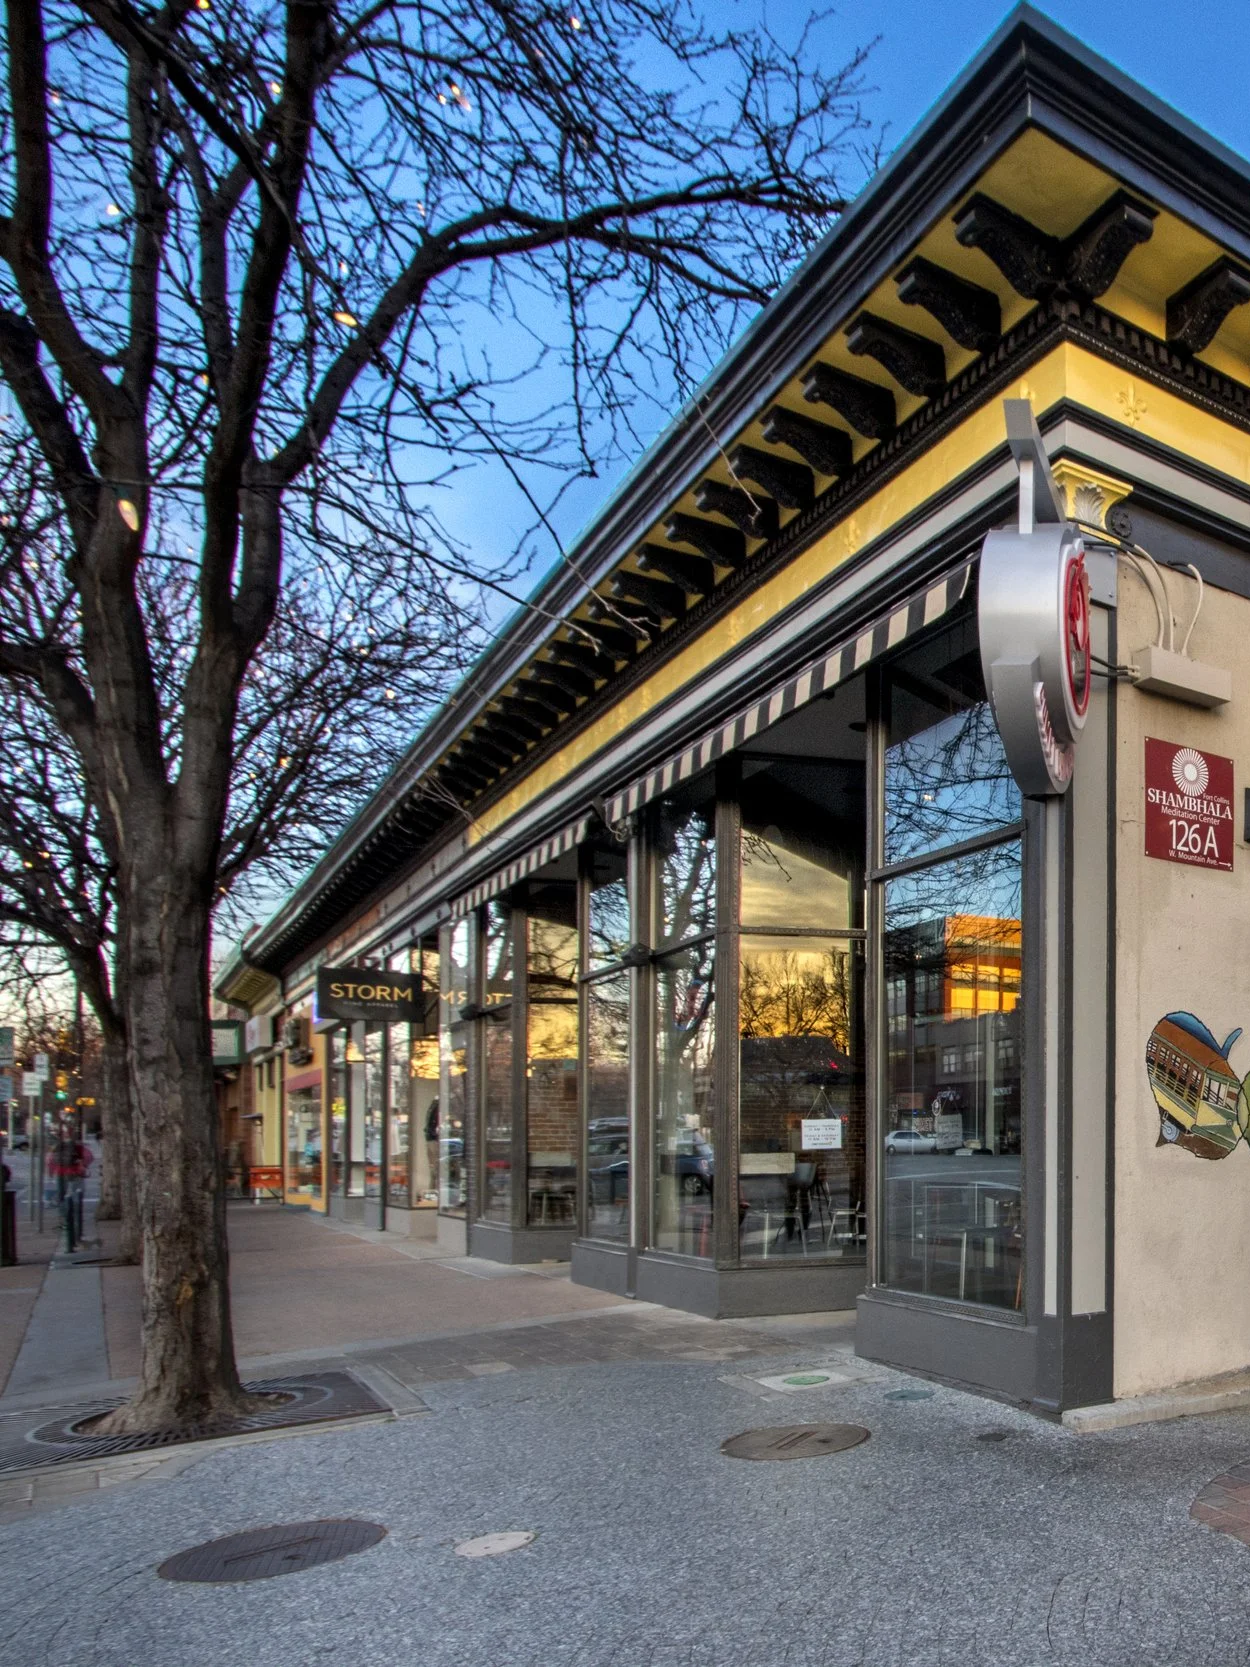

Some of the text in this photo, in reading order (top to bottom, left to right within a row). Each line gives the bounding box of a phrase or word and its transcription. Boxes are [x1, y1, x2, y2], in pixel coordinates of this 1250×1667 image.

[1147, 788, 1233, 820] SHAMBHALA
[1203, 793, 1230, 805] Fort Collins
[1161, 806, 1220, 826] Meditation Center
[1178, 851, 1205, 862] Mountain
[330, 983, 413, 1002] STORM
